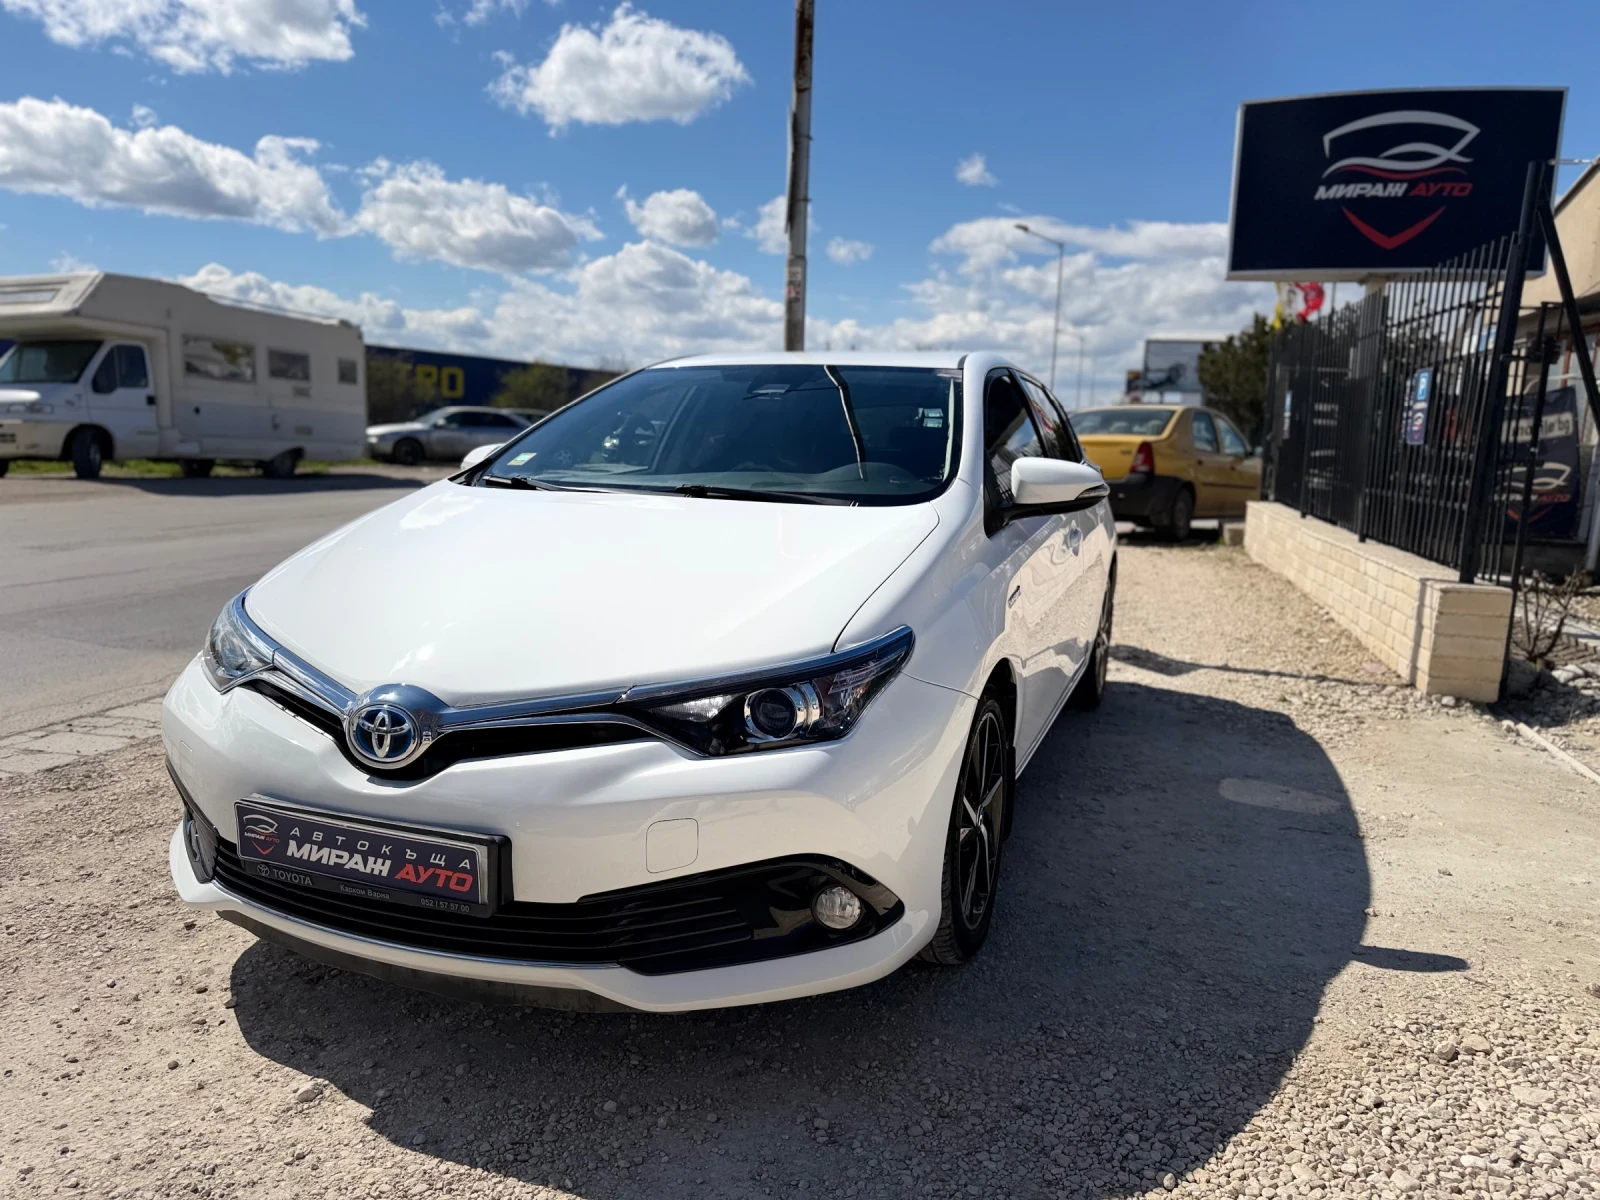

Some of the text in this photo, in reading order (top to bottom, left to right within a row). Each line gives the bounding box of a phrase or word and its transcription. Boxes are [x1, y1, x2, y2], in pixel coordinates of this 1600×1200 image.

[1314, 182, 1473, 200] МИРАЖ АУТО
[244, 831, 265, 840] МИРАЖ
[290, 827, 470, 869] АВТОКЪЩА
[286, 839, 473, 892] МИРАЖ АУТО
[272, 868, 313, 886] TOYOTA
[367, 890, 390, 900] Варна
[420, 897, 434, 907] 052
[440, 901, 448, 909] 57
[460, 904, 470, 912] 00
